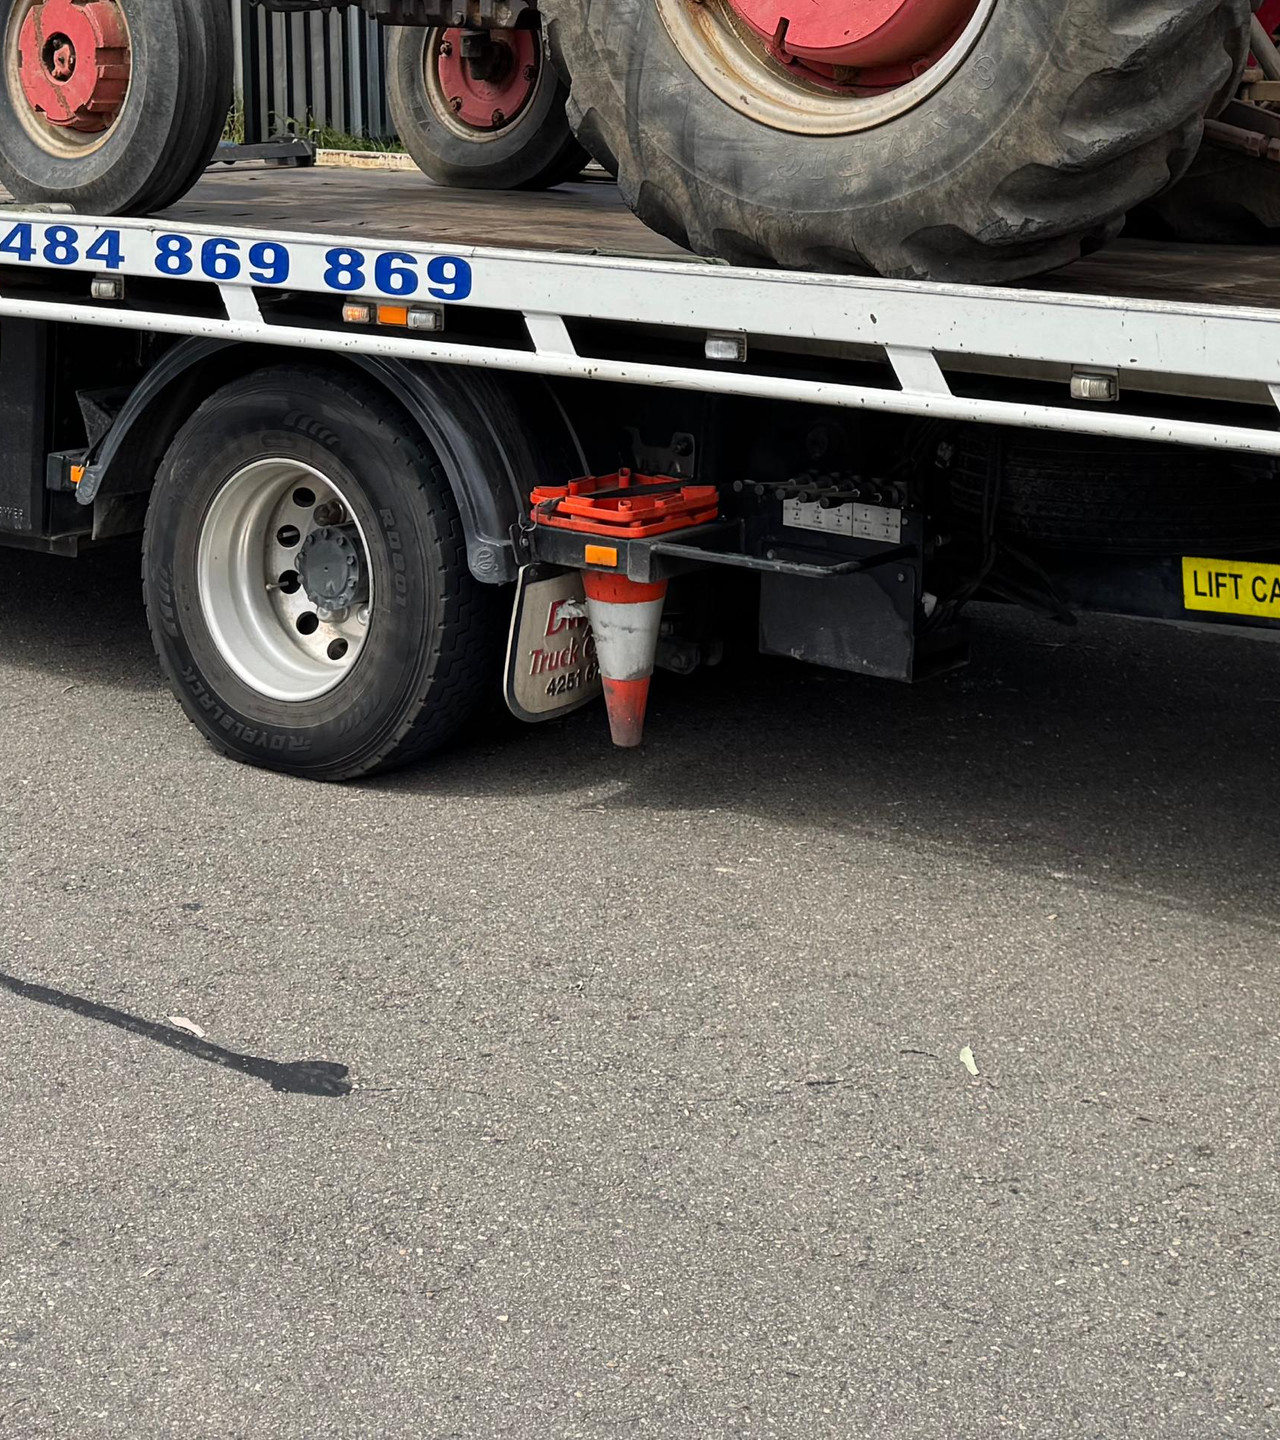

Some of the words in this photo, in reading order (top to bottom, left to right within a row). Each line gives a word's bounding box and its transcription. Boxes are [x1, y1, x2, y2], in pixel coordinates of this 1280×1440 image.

[155, 234, 290, 285] 869
[323, 247, 473, 301] 869
[1193, 570, 1243, 600] LIFT
[528, 637, 579, 676] Truck
